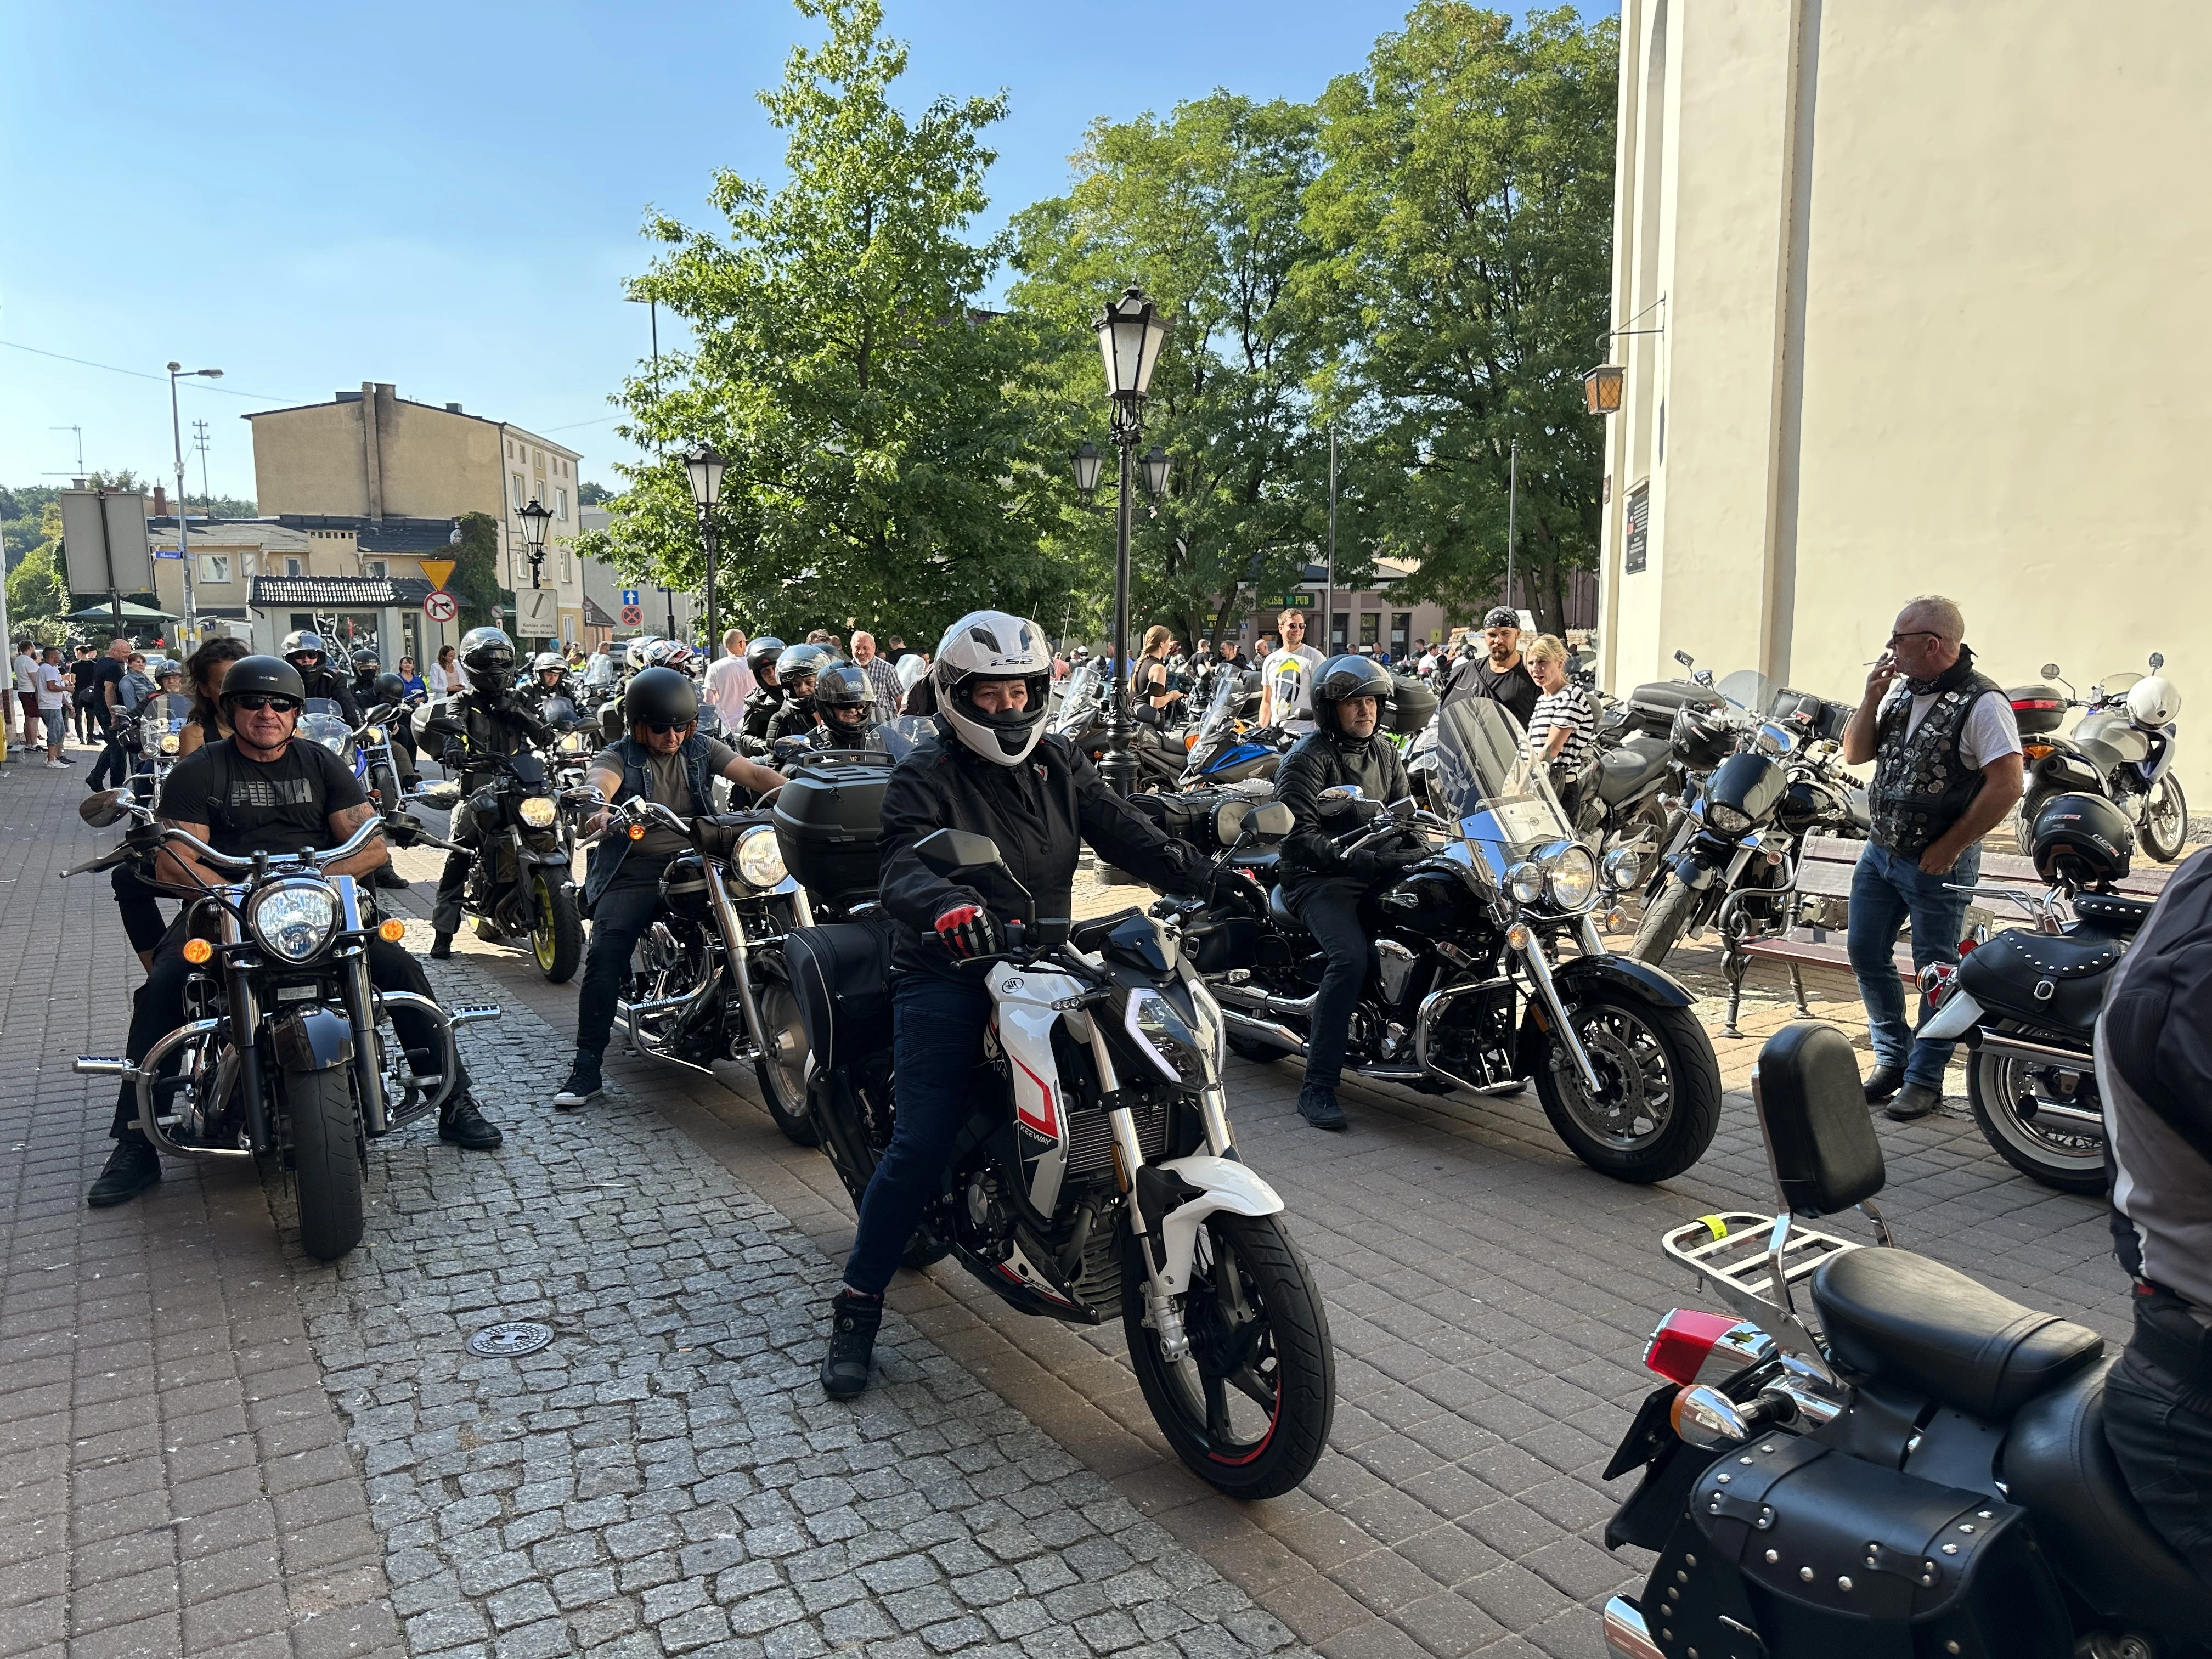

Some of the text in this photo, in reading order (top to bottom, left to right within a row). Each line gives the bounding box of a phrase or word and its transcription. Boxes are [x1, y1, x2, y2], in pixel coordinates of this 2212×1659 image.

[1295, 596, 1309, 605] PUB
[991, 658, 1033, 667] LS2
[1020, 1124, 1052, 1146] KEEWAY
